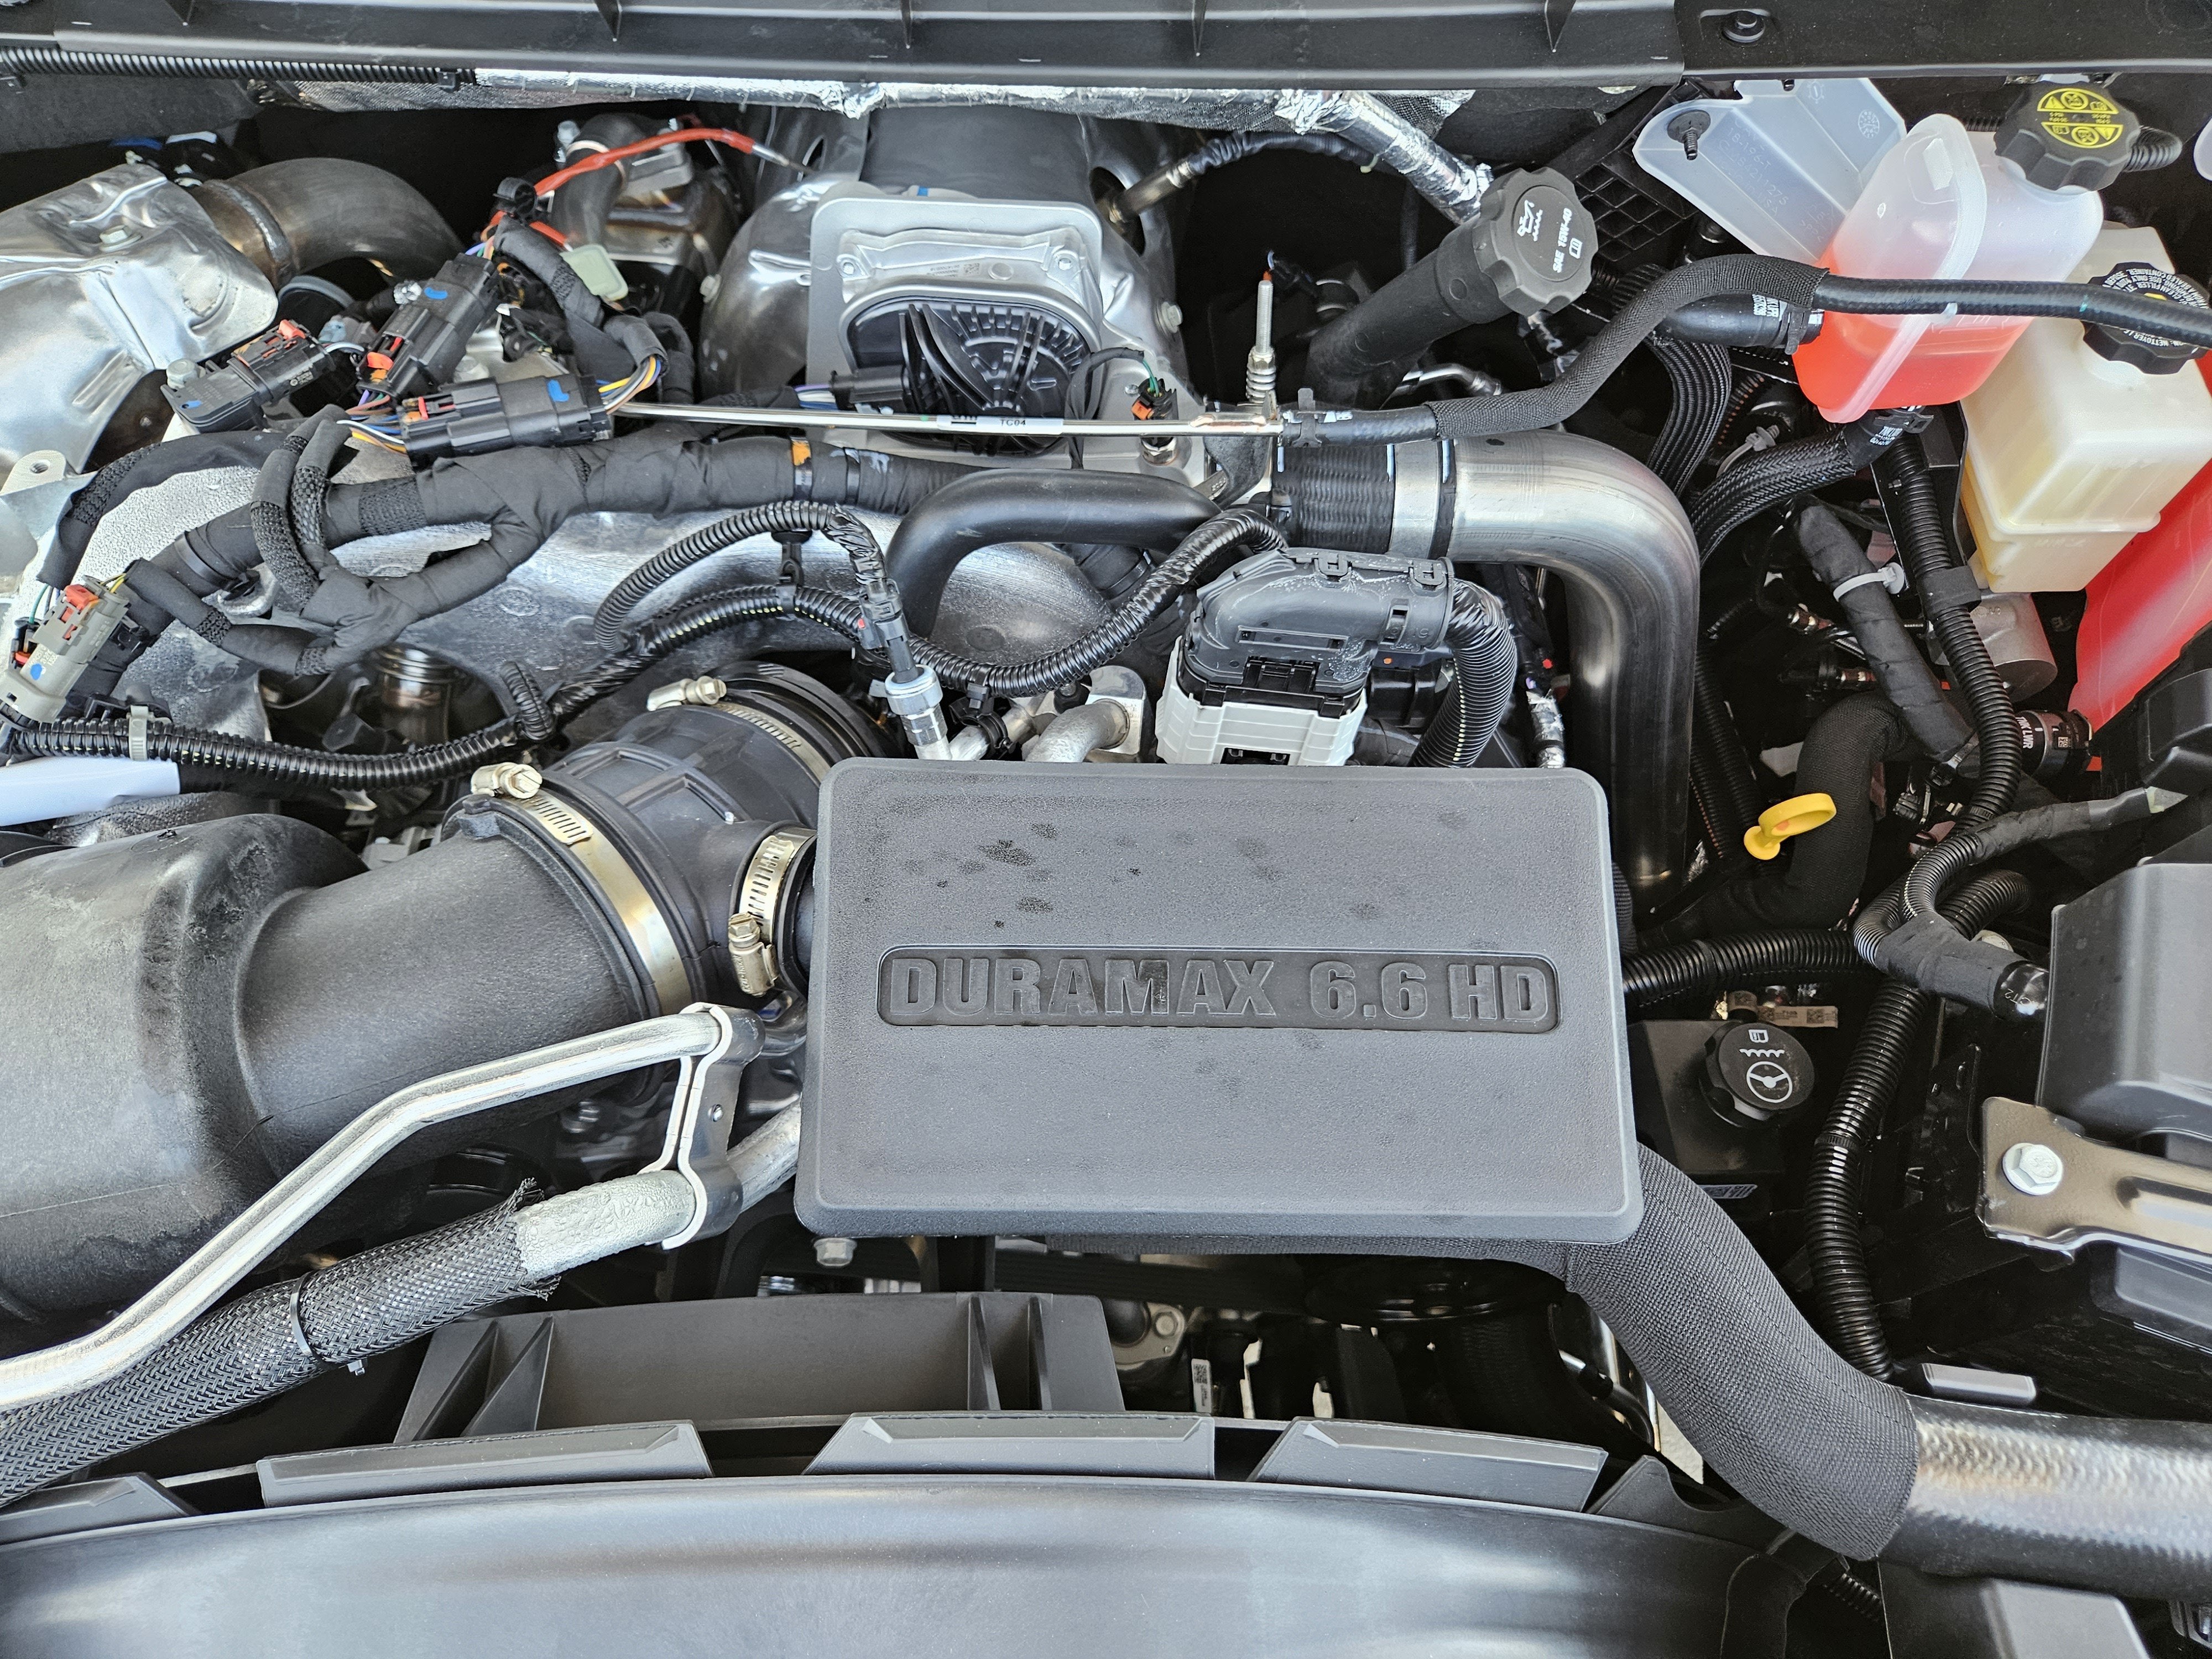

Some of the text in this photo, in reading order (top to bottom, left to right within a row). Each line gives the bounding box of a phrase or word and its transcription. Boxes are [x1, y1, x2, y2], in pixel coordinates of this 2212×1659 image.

[1727, 128, 1772, 170] 18-196-T
[1553, 208, 1572, 273] SAE 15W-40
[2136, 281, 2161, 291] FILLER
[2148, 275, 2162, 284] USE
[1766, 305, 1780, 317] UPR
[2133, 332, 2169, 347] NETTOYER
[2015, 716, 2034, 749] TNK LWR
[889, 958, 1549, 1023] DURAMAX 6.6 HD
